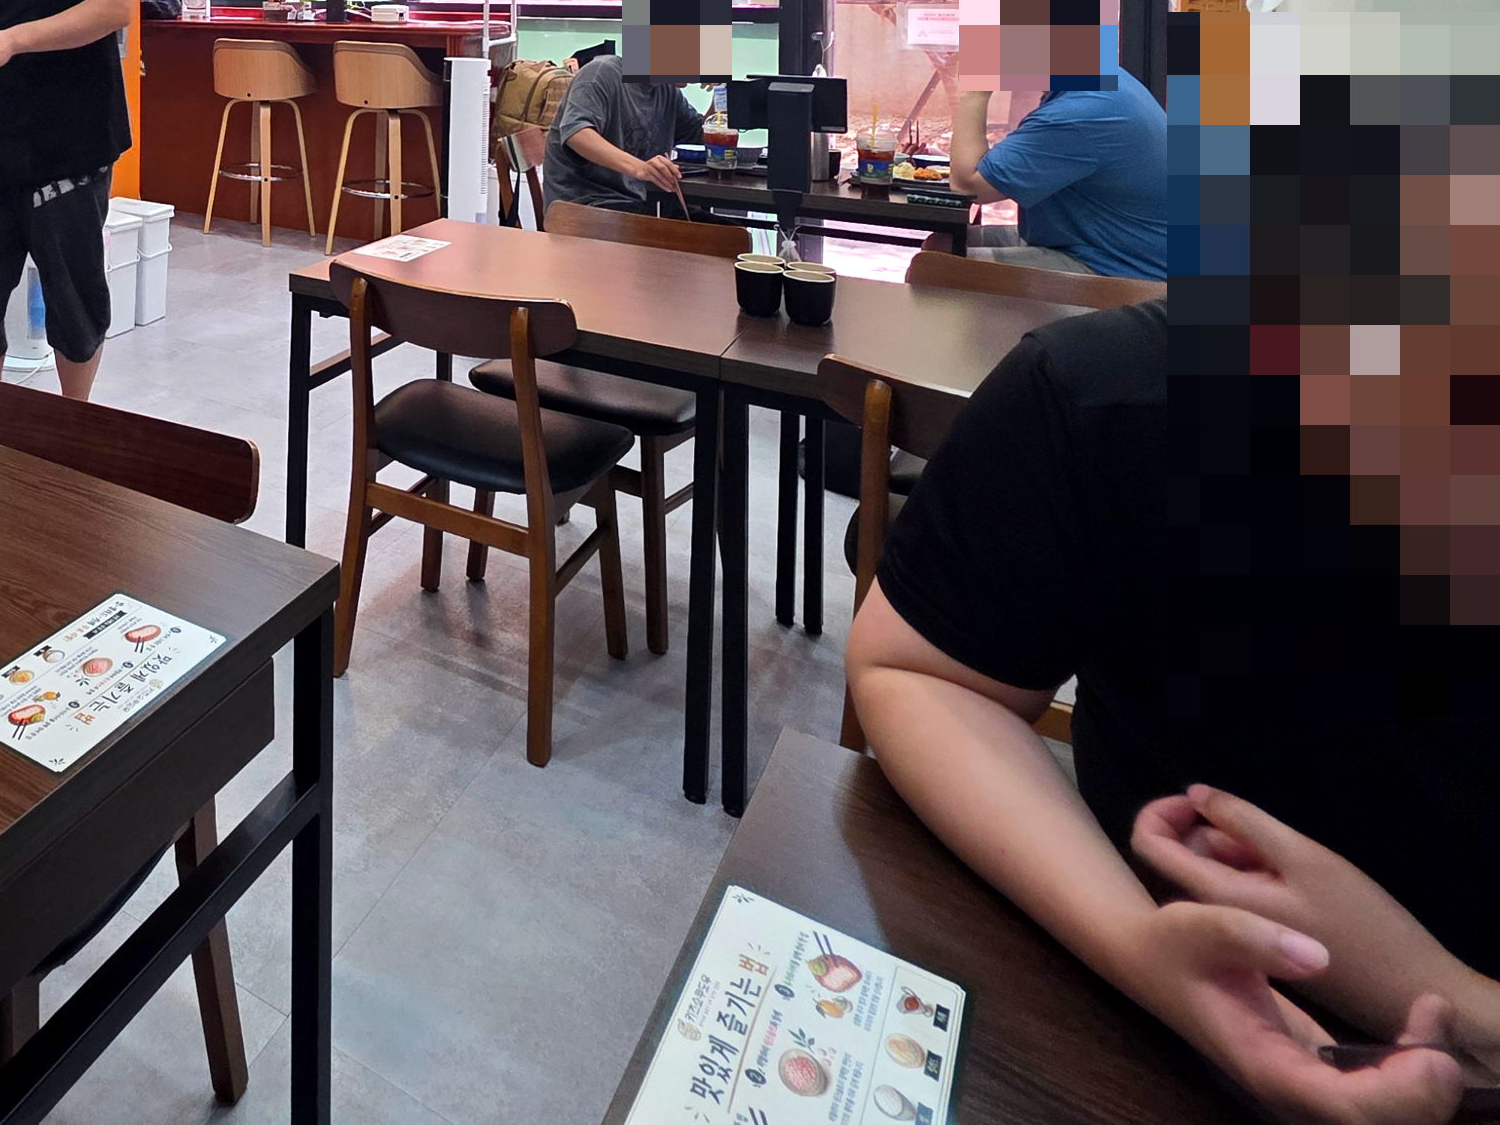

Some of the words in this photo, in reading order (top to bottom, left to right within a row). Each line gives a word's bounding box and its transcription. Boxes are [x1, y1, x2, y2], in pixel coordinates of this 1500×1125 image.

[130, 654, 172, 682] 맛있게
[89, 682, 134, 712] 즐기는
[74, 712, 95, 725] 법
[738, 953, 769, 976] 법
[716, 977, 761, 1035] 즐기는
[690, 1034, 740, 1105] 맛있게
